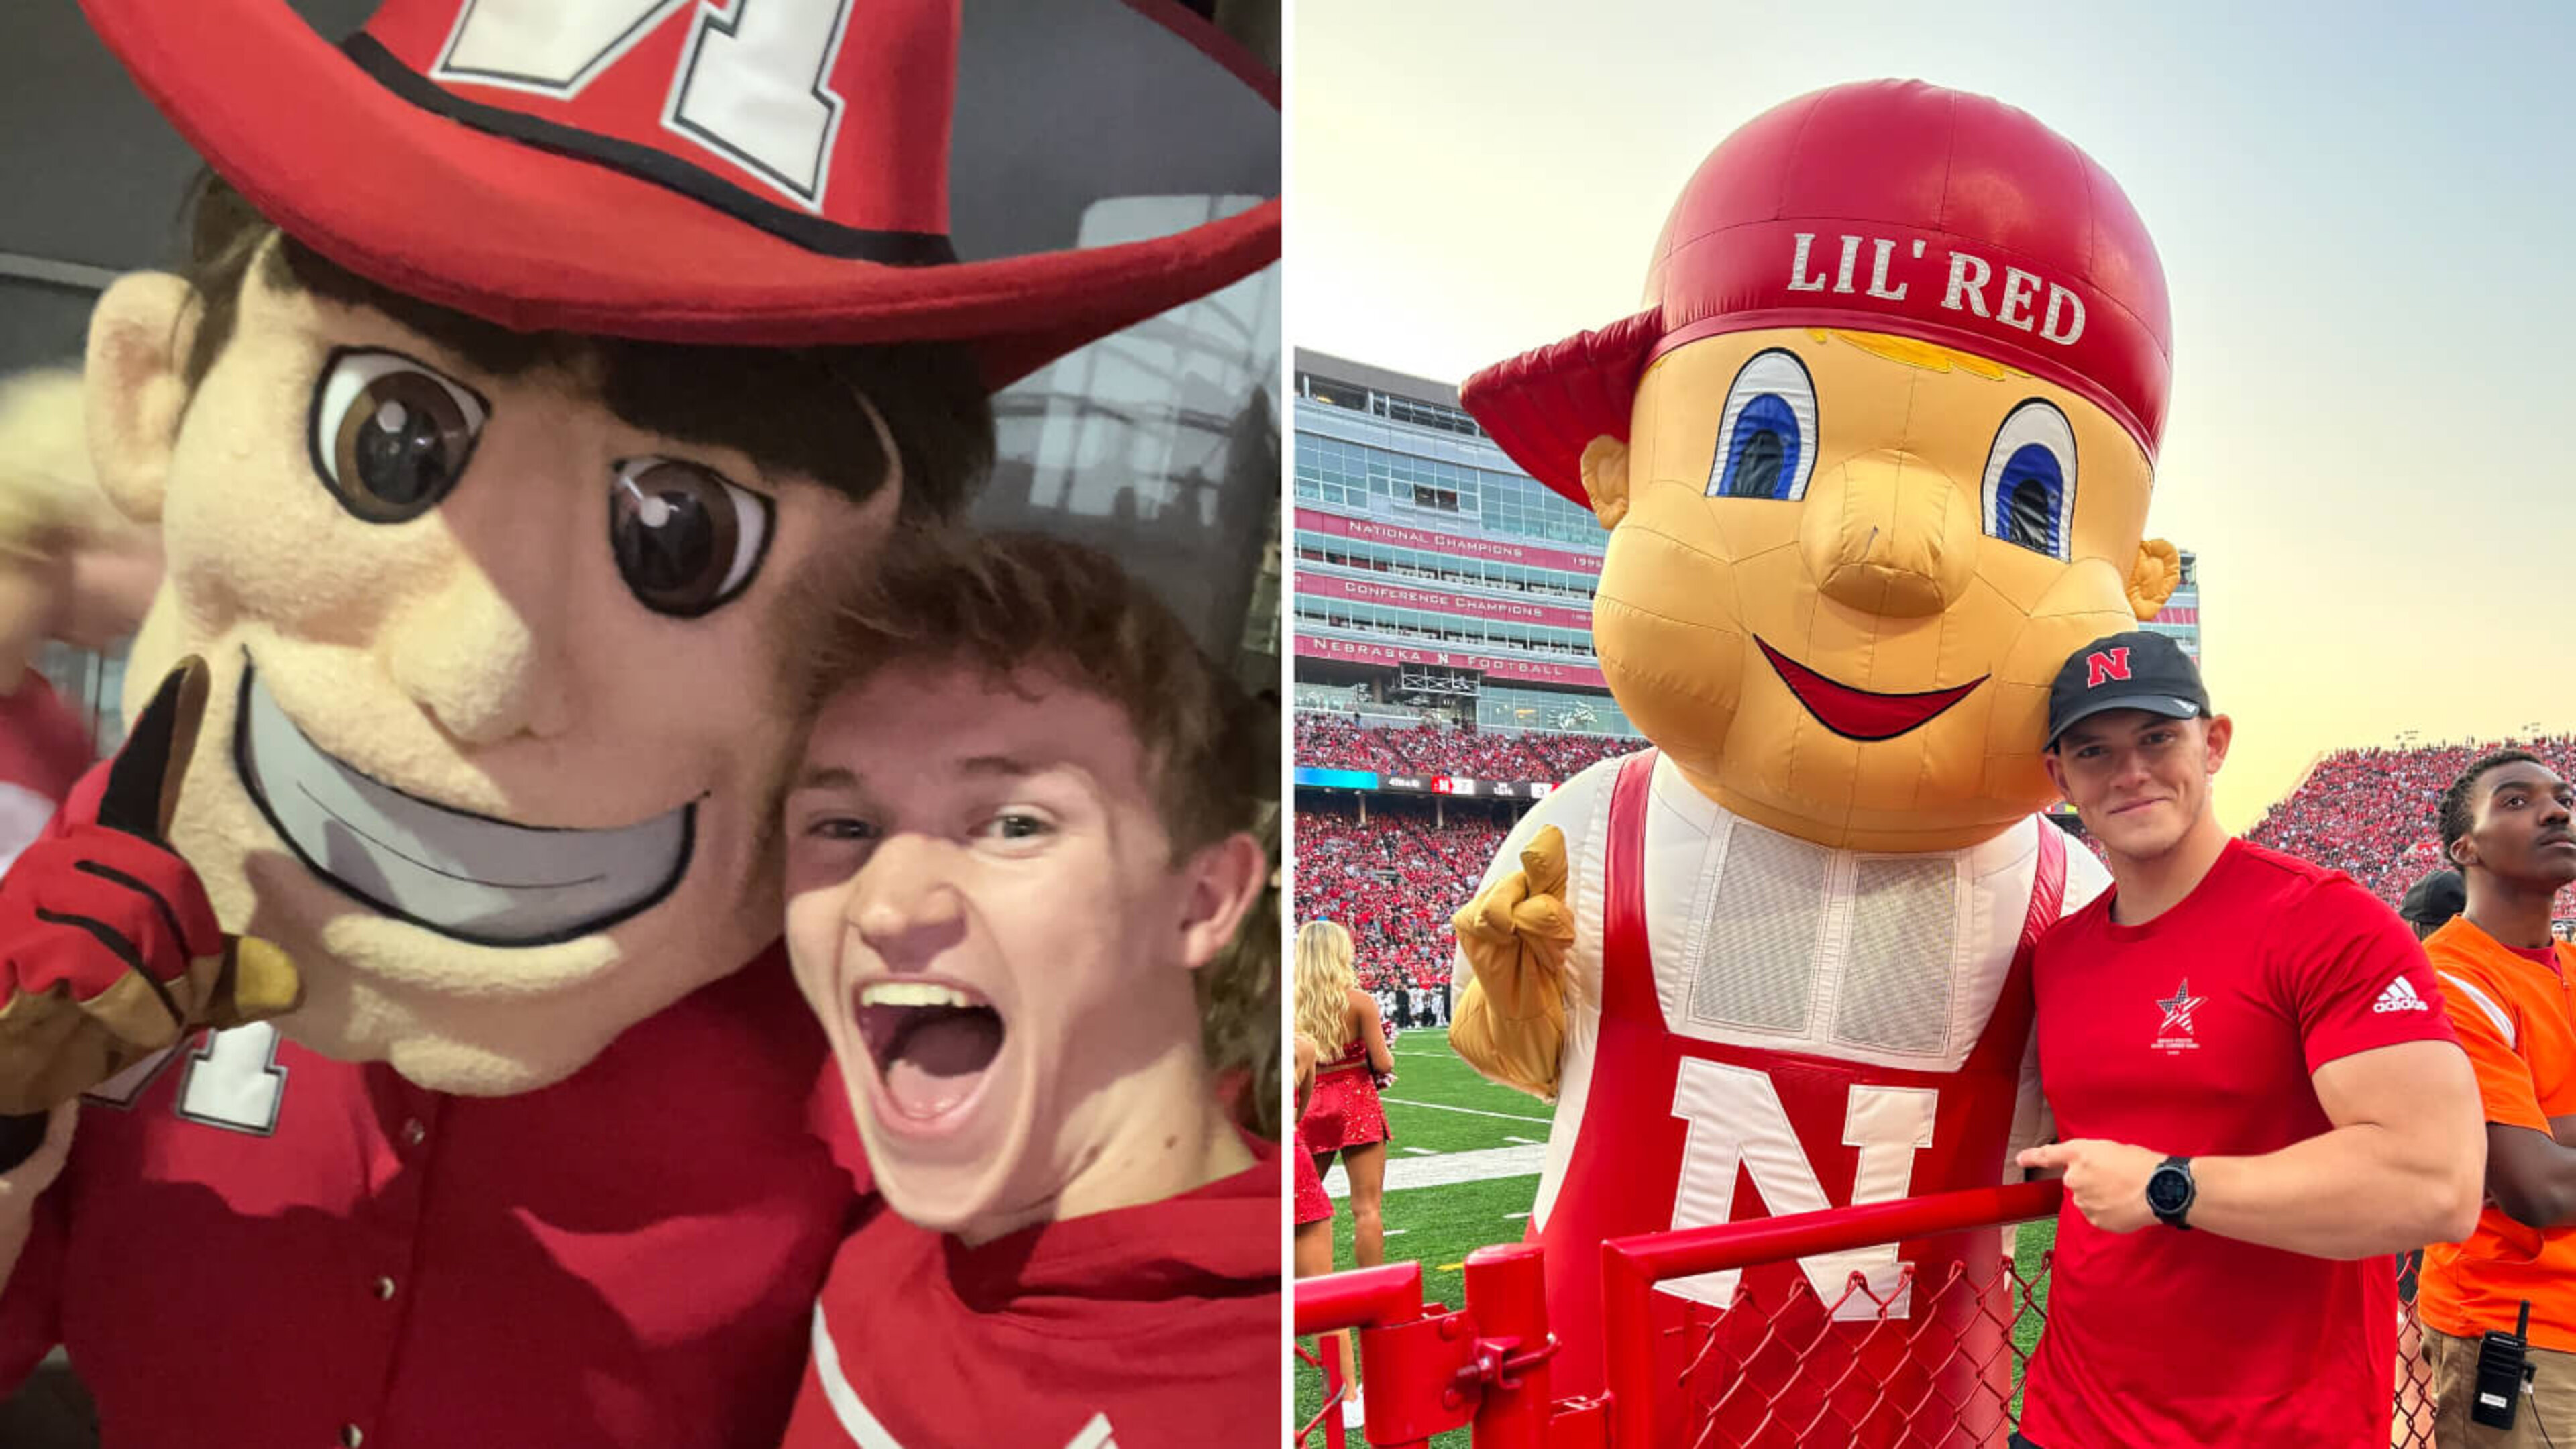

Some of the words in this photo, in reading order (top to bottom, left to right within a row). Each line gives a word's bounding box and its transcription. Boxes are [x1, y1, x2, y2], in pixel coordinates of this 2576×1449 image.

[1788, 233, 1927, 301] LIL'
[1941, 250, 2086, 346] RED
[1350, 521, 1430, 543] NATIONAL
[1434, 535, 1523, 557] CHAMPIONS
[1344, 581, 1450, 605] CONFERENCE
[1455, 597, 1543, 618] CHAMPIONS
[1313, 638, 1421, 662] NEBRASKA
[1437, 653, 1449, 665] N
[1467, 656, 1564, 676] FOOTBALL
[2087, 647, 2131, 688] N
[2373, 998, 2428, 1014] adidas
[1652, 1055, 1939, 1322] N
